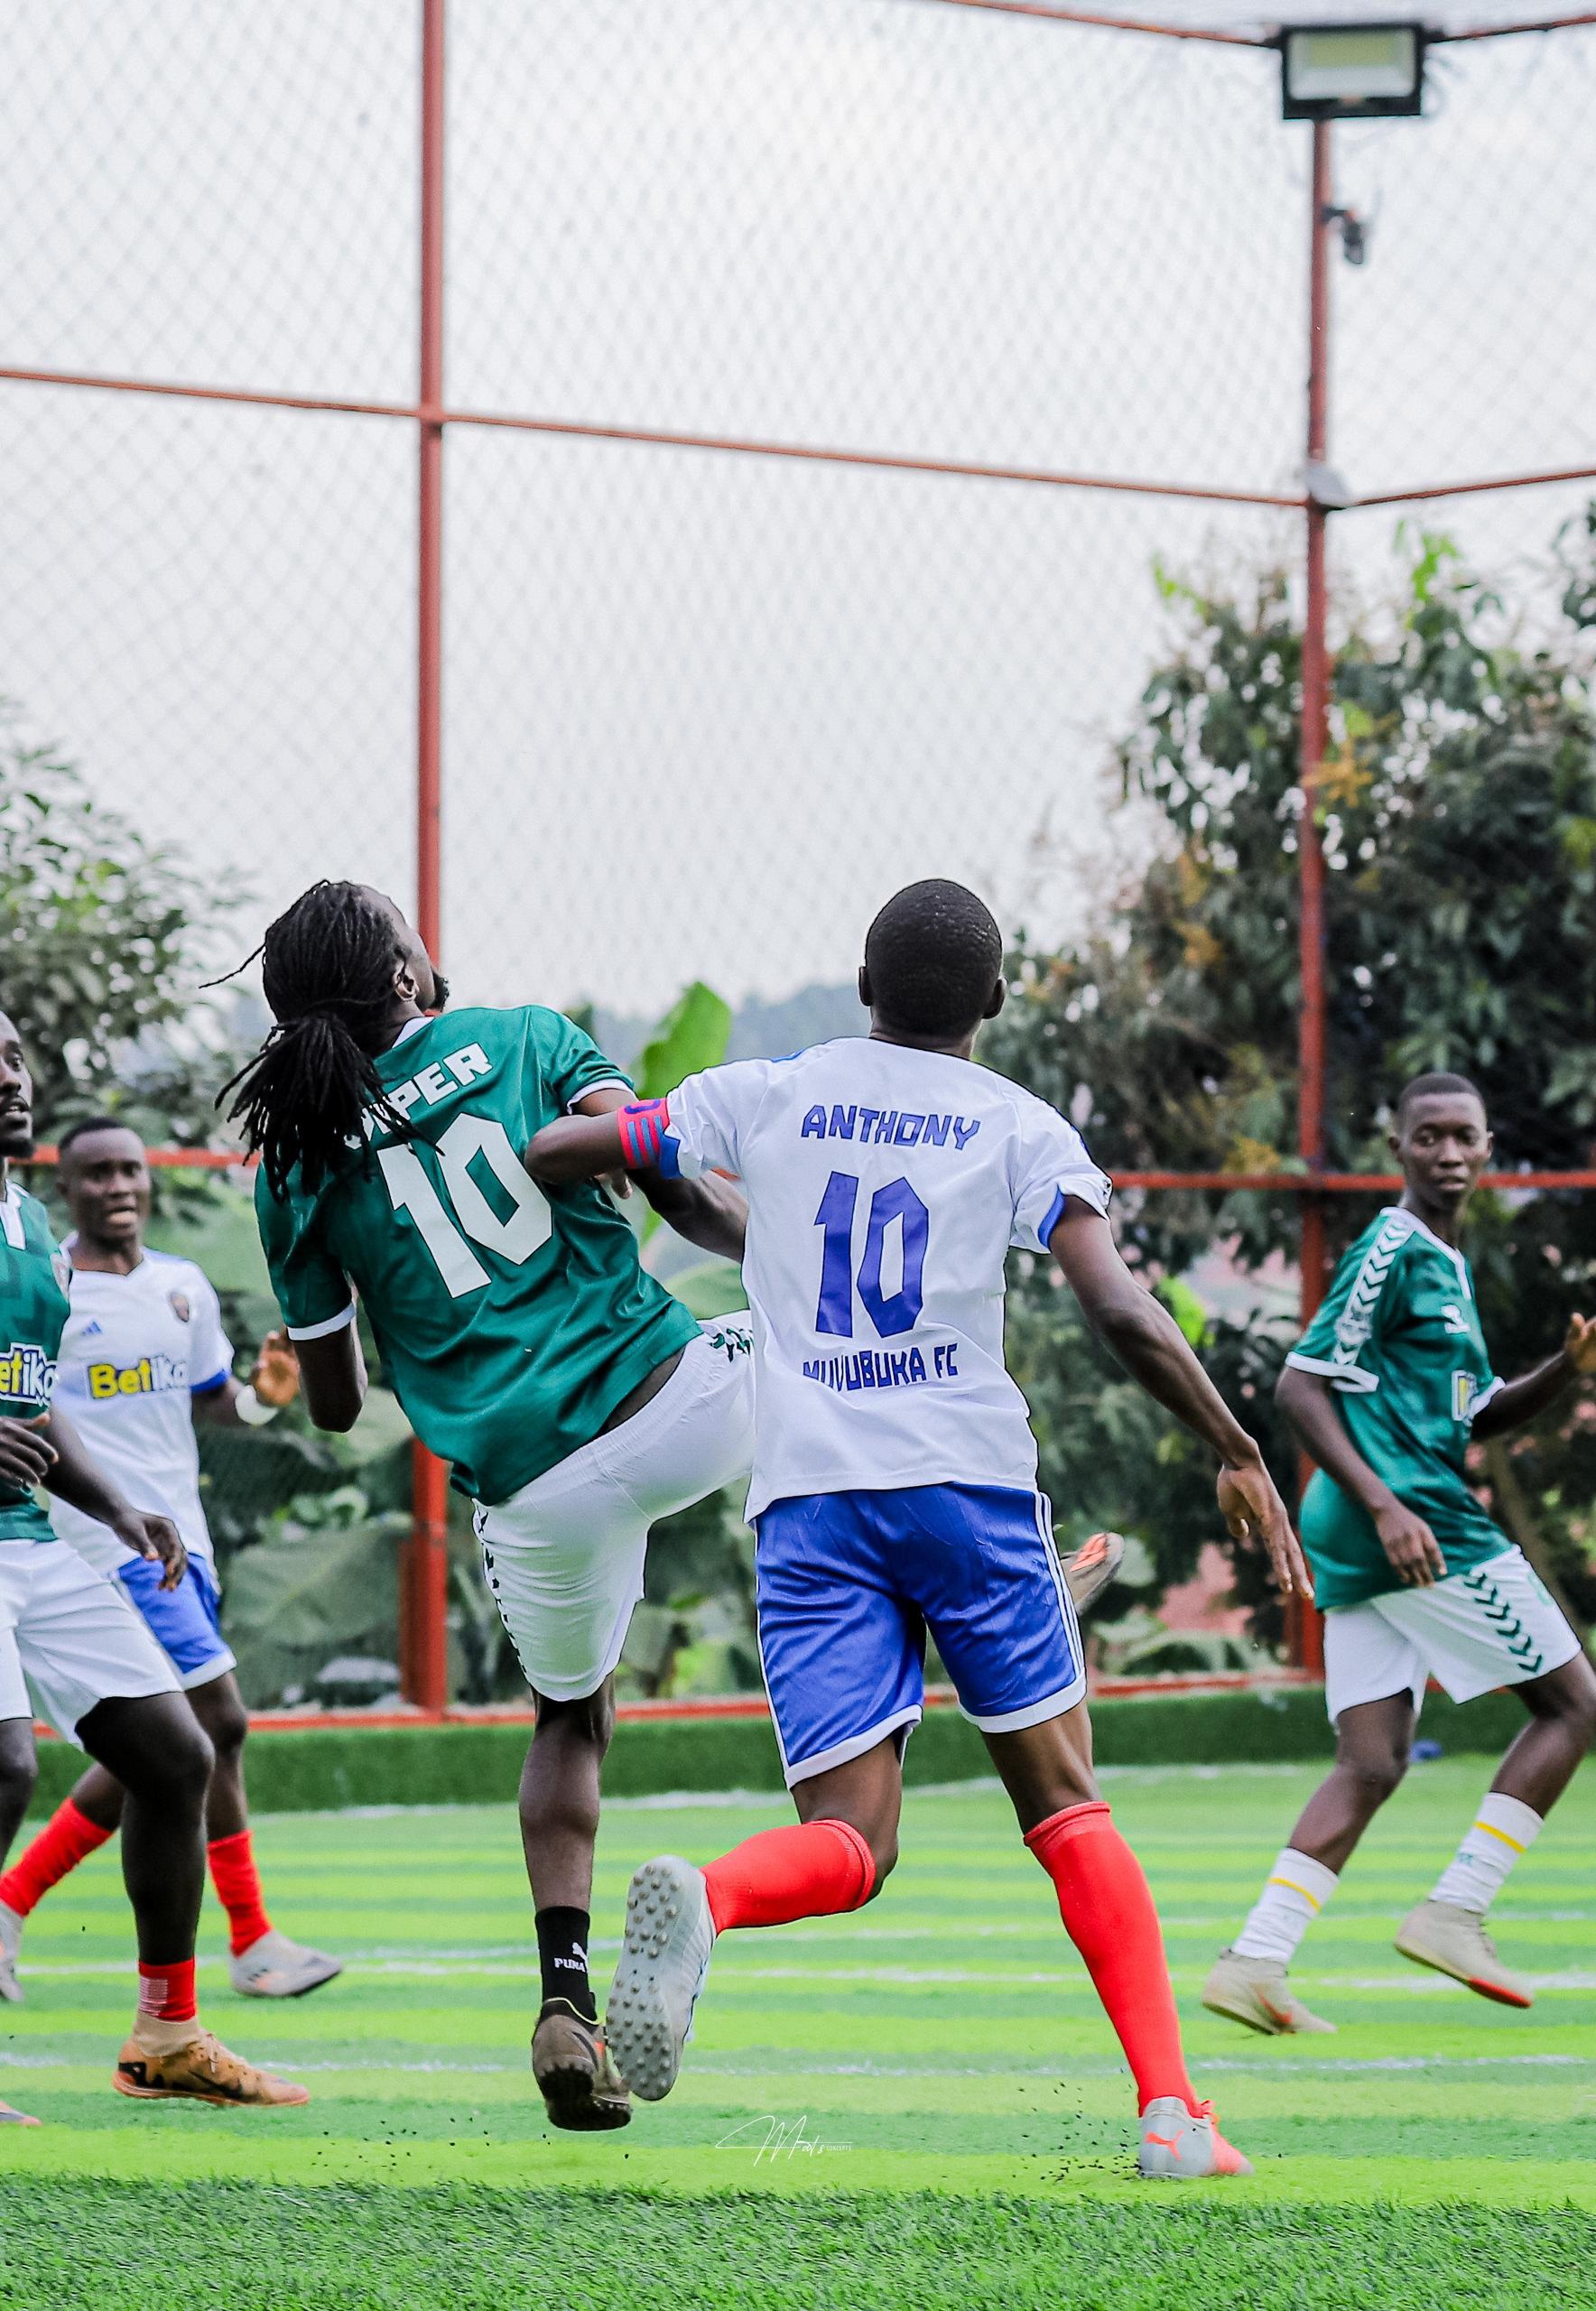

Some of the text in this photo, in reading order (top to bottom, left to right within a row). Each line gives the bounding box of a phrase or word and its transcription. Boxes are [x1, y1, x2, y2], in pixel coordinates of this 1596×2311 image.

[800, 1104, 981, 1151] ANTHONY
[376, 1111, 553, 1300] 10
[813, 1170, 929, 1339] 10
[803, 1342, 959, 1392] MUVUBUKA FC
